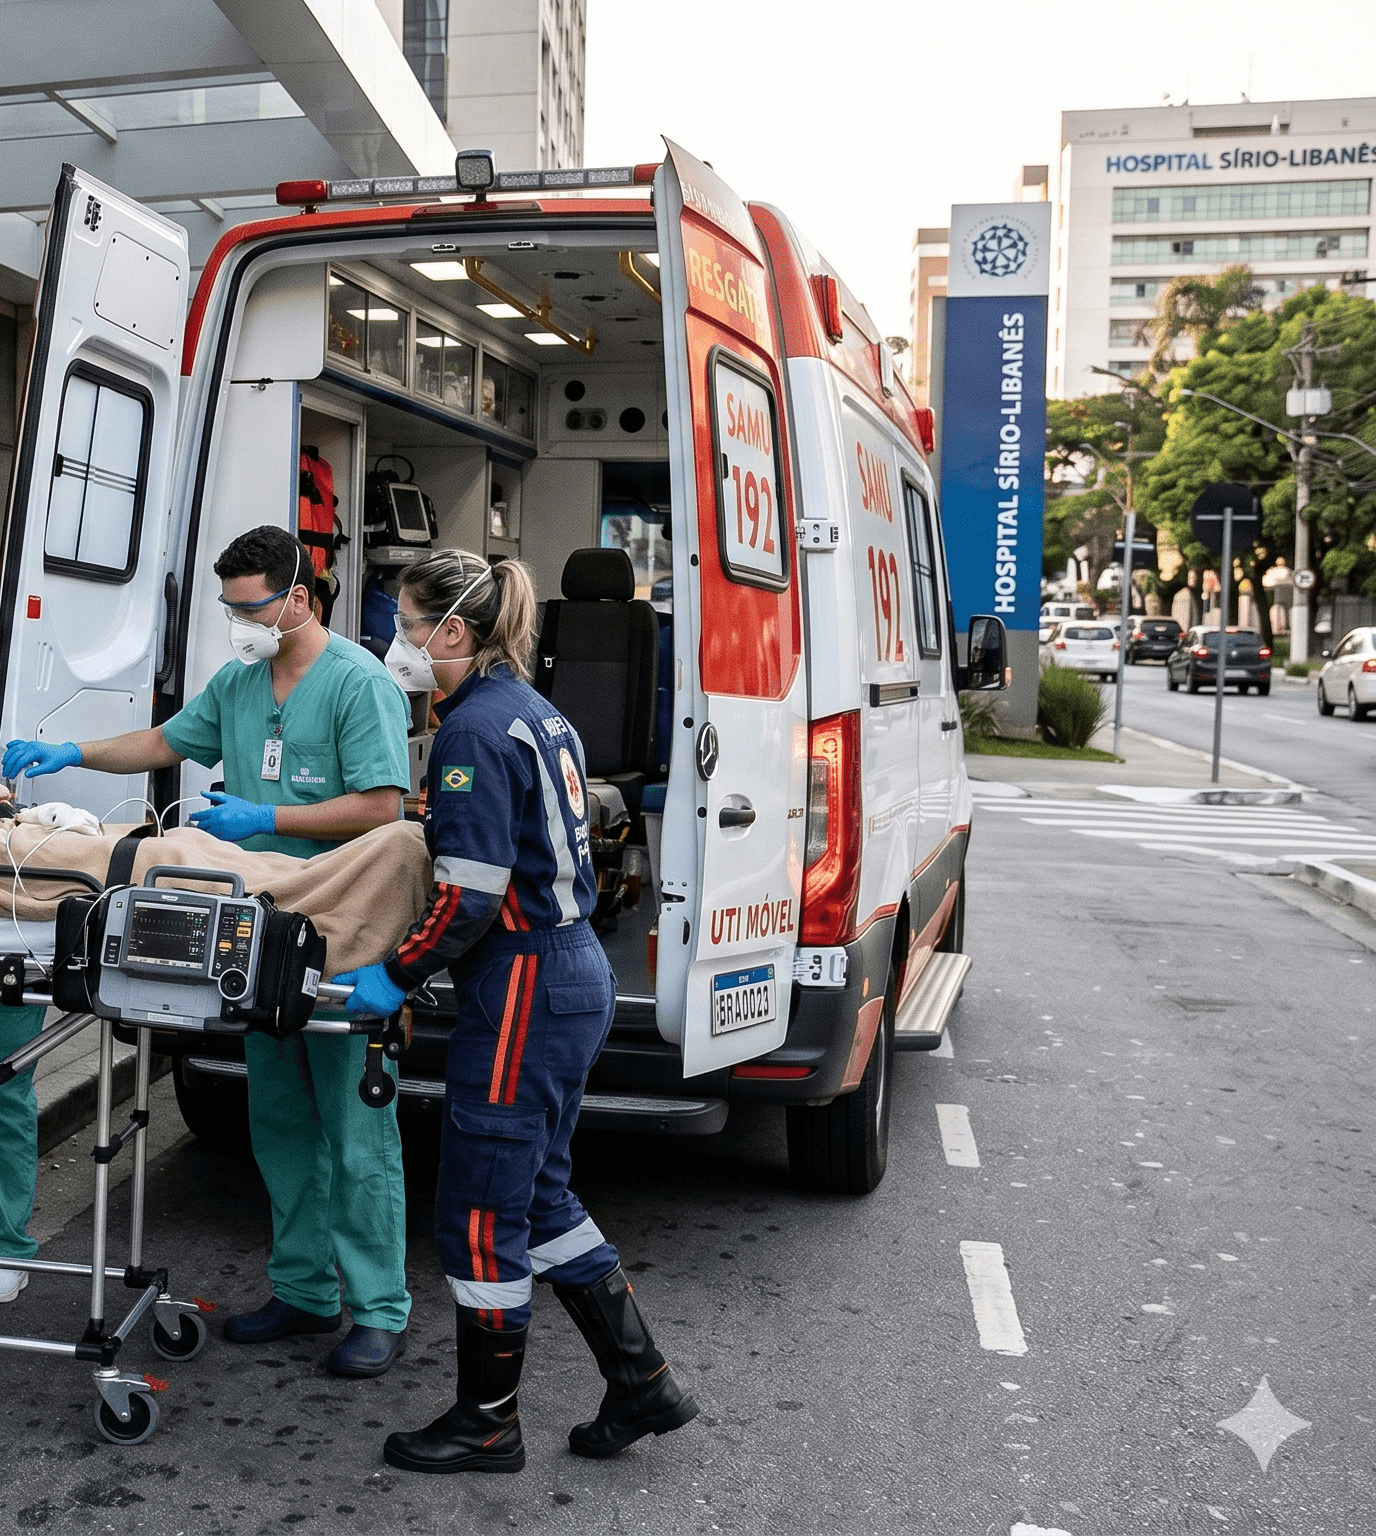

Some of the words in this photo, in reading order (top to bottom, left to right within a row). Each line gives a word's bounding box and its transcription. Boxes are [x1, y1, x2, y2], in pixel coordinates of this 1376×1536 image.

[1106, 153, 1213, 173] HOSPITAL
[727, 392, 771, 456] SAMU
[994, 312, 1024, 490] SÍRIO-LIBANÊS
[733, 464, 775, 555] 192
[856, 442, 892, 523] SAMU
[994, 495, 1019, 613] HOSPITAL
[868, 545, 904, 662] 192
[710, 906, 742, 945] UTI
[745, 893, 794, 941] MÓVEL
